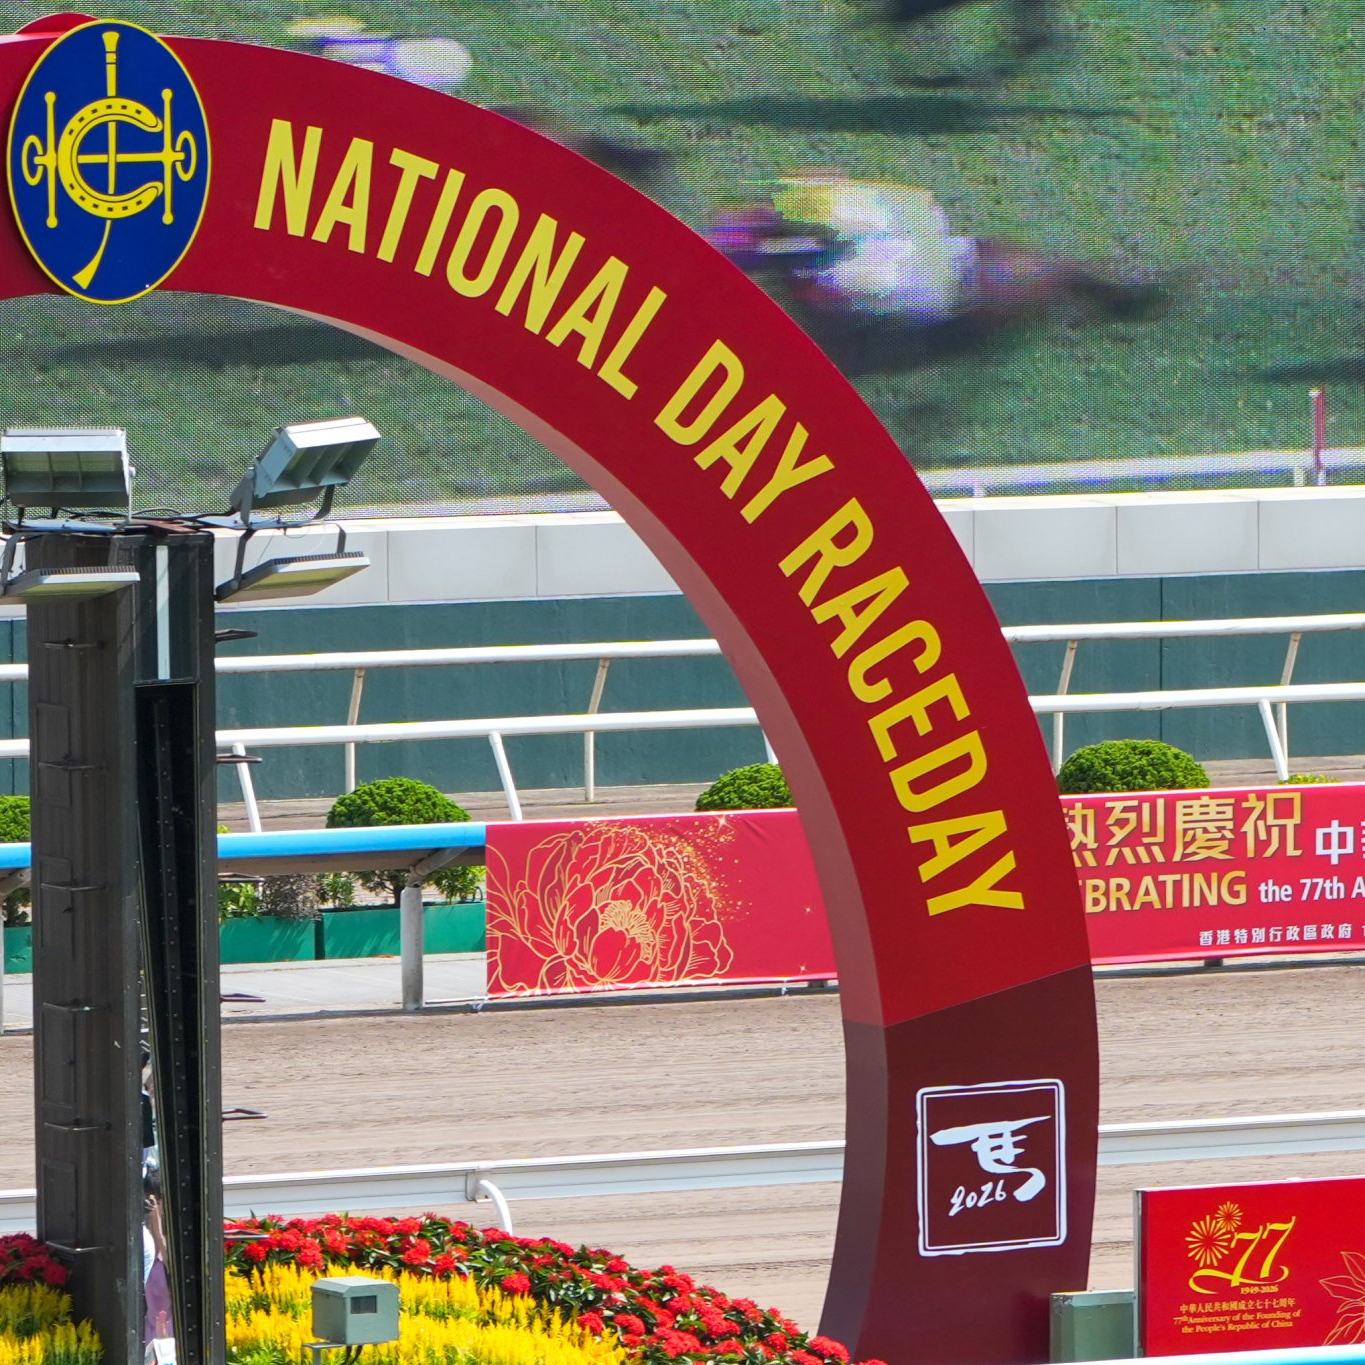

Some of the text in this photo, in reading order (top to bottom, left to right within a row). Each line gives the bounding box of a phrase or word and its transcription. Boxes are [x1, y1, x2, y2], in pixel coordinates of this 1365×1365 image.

[254, 118, 1025, 917] NATIONAL DAY RACEDAY
[1079, 870, 1248, 914] BRATING
[1258, 879, 1293, 903] the
[1299, 876, 1345, 900] 77th
[1199, 923, 1352, 946] 香港特別行政區政府
[948, 1179, 1007, 1217] 2026
